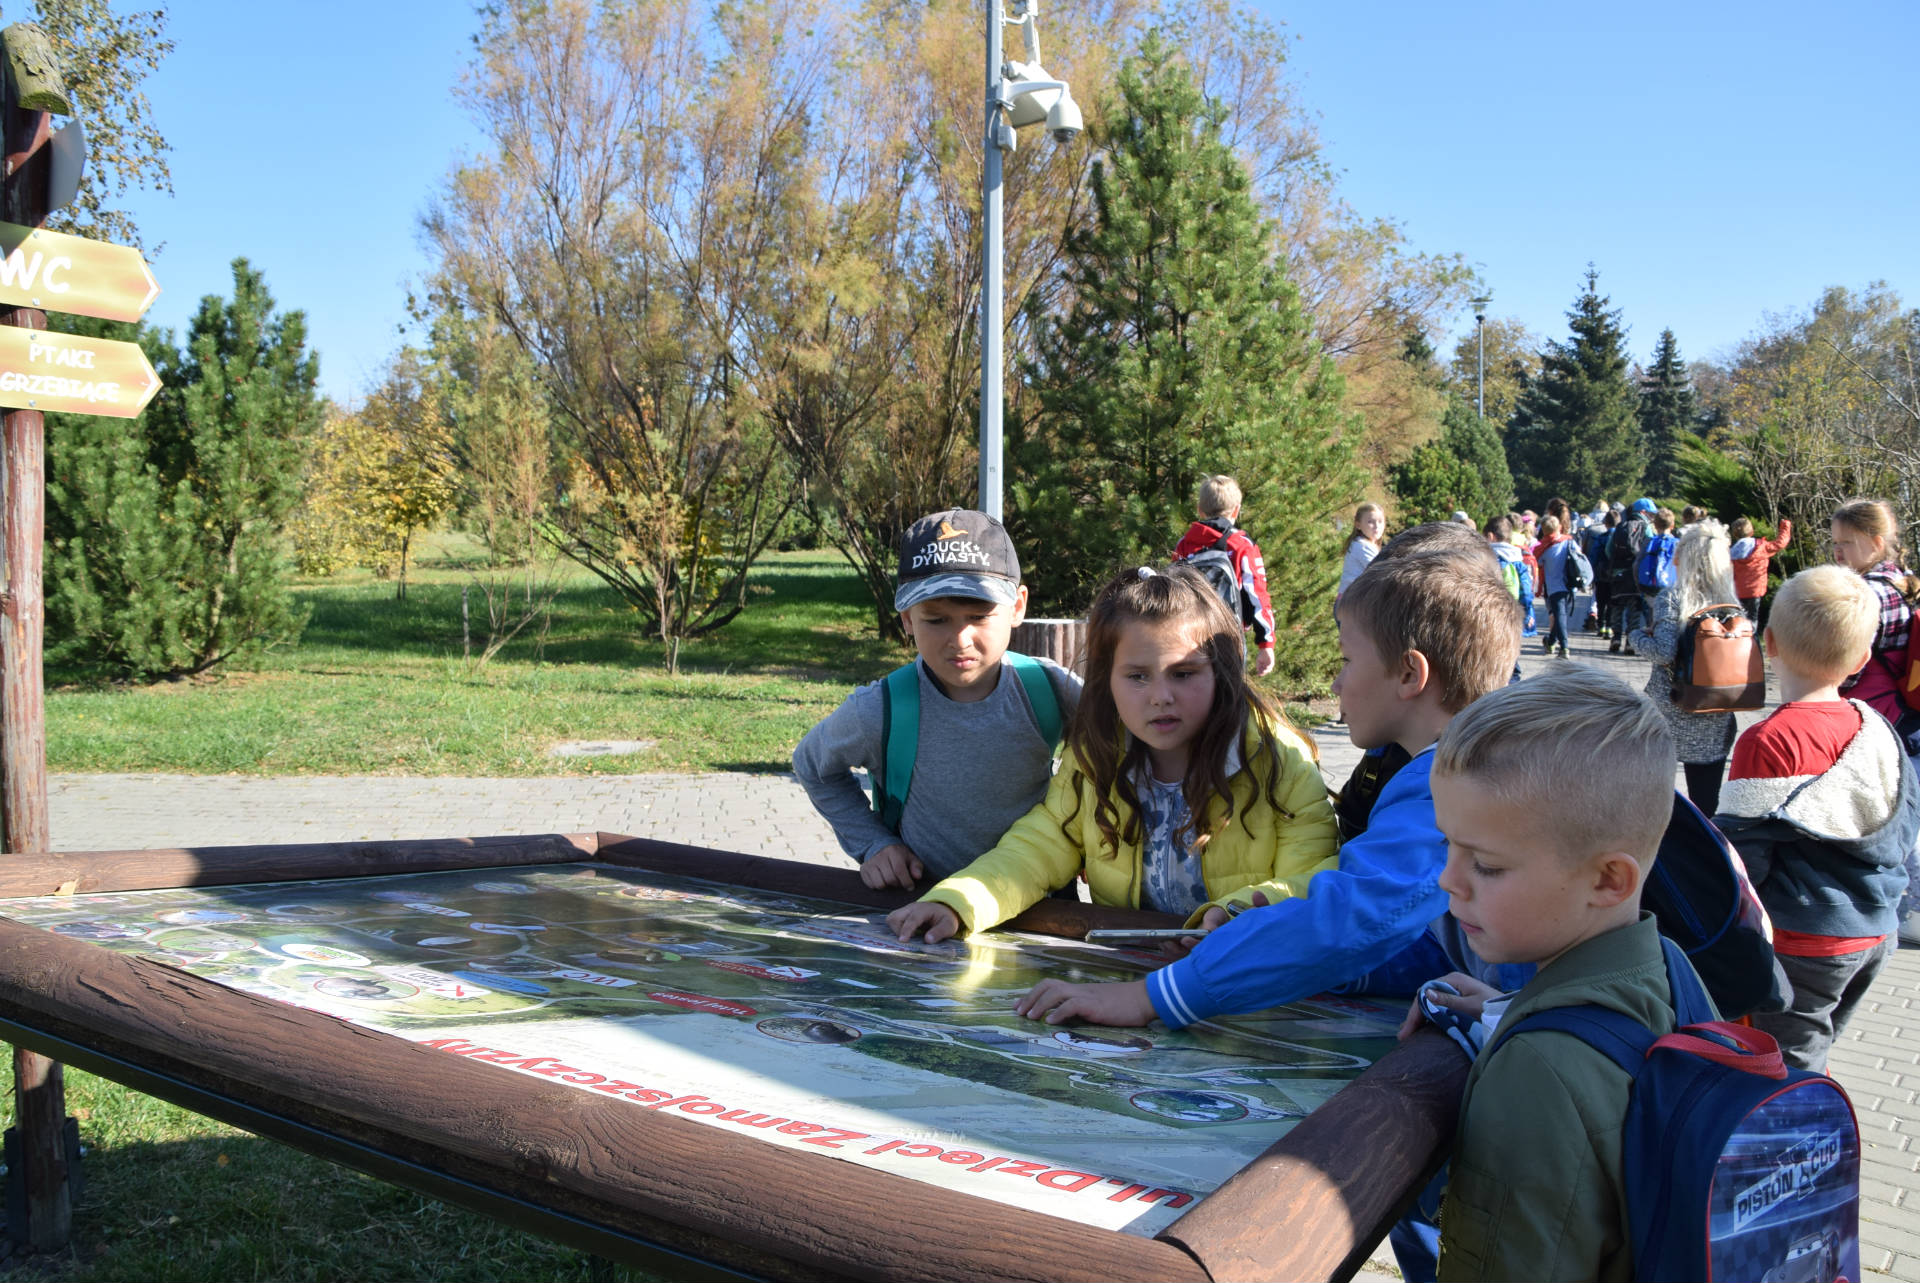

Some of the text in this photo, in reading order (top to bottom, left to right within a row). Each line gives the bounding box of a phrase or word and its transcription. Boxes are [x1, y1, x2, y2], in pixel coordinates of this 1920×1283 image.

[0, 247, 72, 294] WC
[29, 343, 96, 369] PTAKI
[0, 371, 121, 403] GRZEBIĄCE
[911, 551, 991, 569] DYNASTY
[926, 541, 972, 554] DUCK
[562, 972, 619, 986] WC
[419, 1038, 868, 1148] Zamojszczyzny
[1737, 1139, 1838, 1223] PISTON CUP
